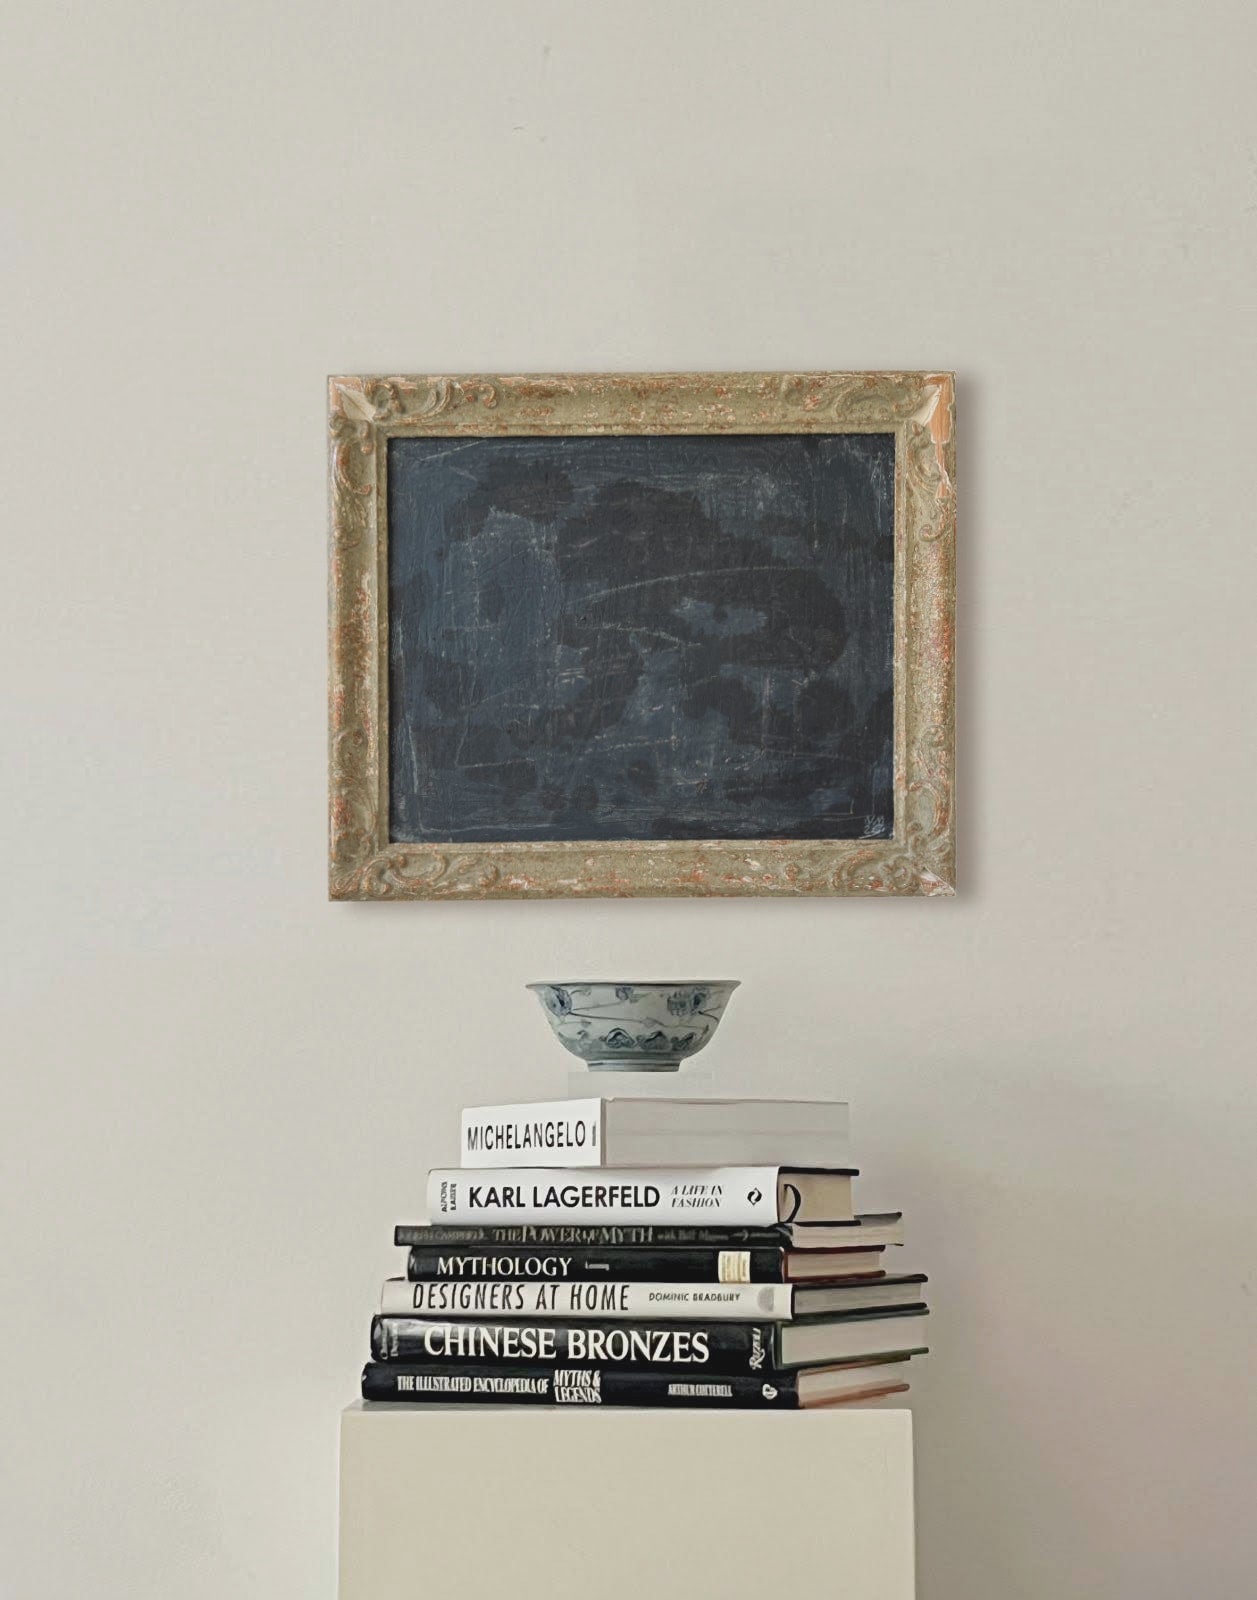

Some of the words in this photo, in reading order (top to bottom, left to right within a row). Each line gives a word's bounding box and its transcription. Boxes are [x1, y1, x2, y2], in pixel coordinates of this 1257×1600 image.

[467, 1120, 586, 1151] MICHELANGELO
[468, 1186, 526, 1208] KARL
[533, 1186, 661, 1208] LAGERFELD
[671, 1198, 721, 1208] FASHION
[493, 1229, 522, 1242] THE
[522, 1226, 582, 1243] POWER
[436, 1257, 572, 1276] MYTHOLOGY
[413, 1283, 526, 1310] DESIGNERS
[535, 1283, 562, 1310] AT
[569, 1284, 630, 1311] HOME
[649, 1293, 690, 1302] DOMINIC
[693, 1293, 741, 1302] BRADBURY
[424, 1326, 557, 1358] CHINESE
[567, 1328, 710, 1364] BRONZES
[397, 1375, 415, 1391] THE
[416, 1376, 471, 1392] ILLUSTRATED
[473, 1377, 536, 1393] ENCYCLOPEDIA
[537, 1378, 549, 1394] OF
[553, 1369, 591, 1386] MYTHS
[555, 1386, 602, 1403] LEGENDS
